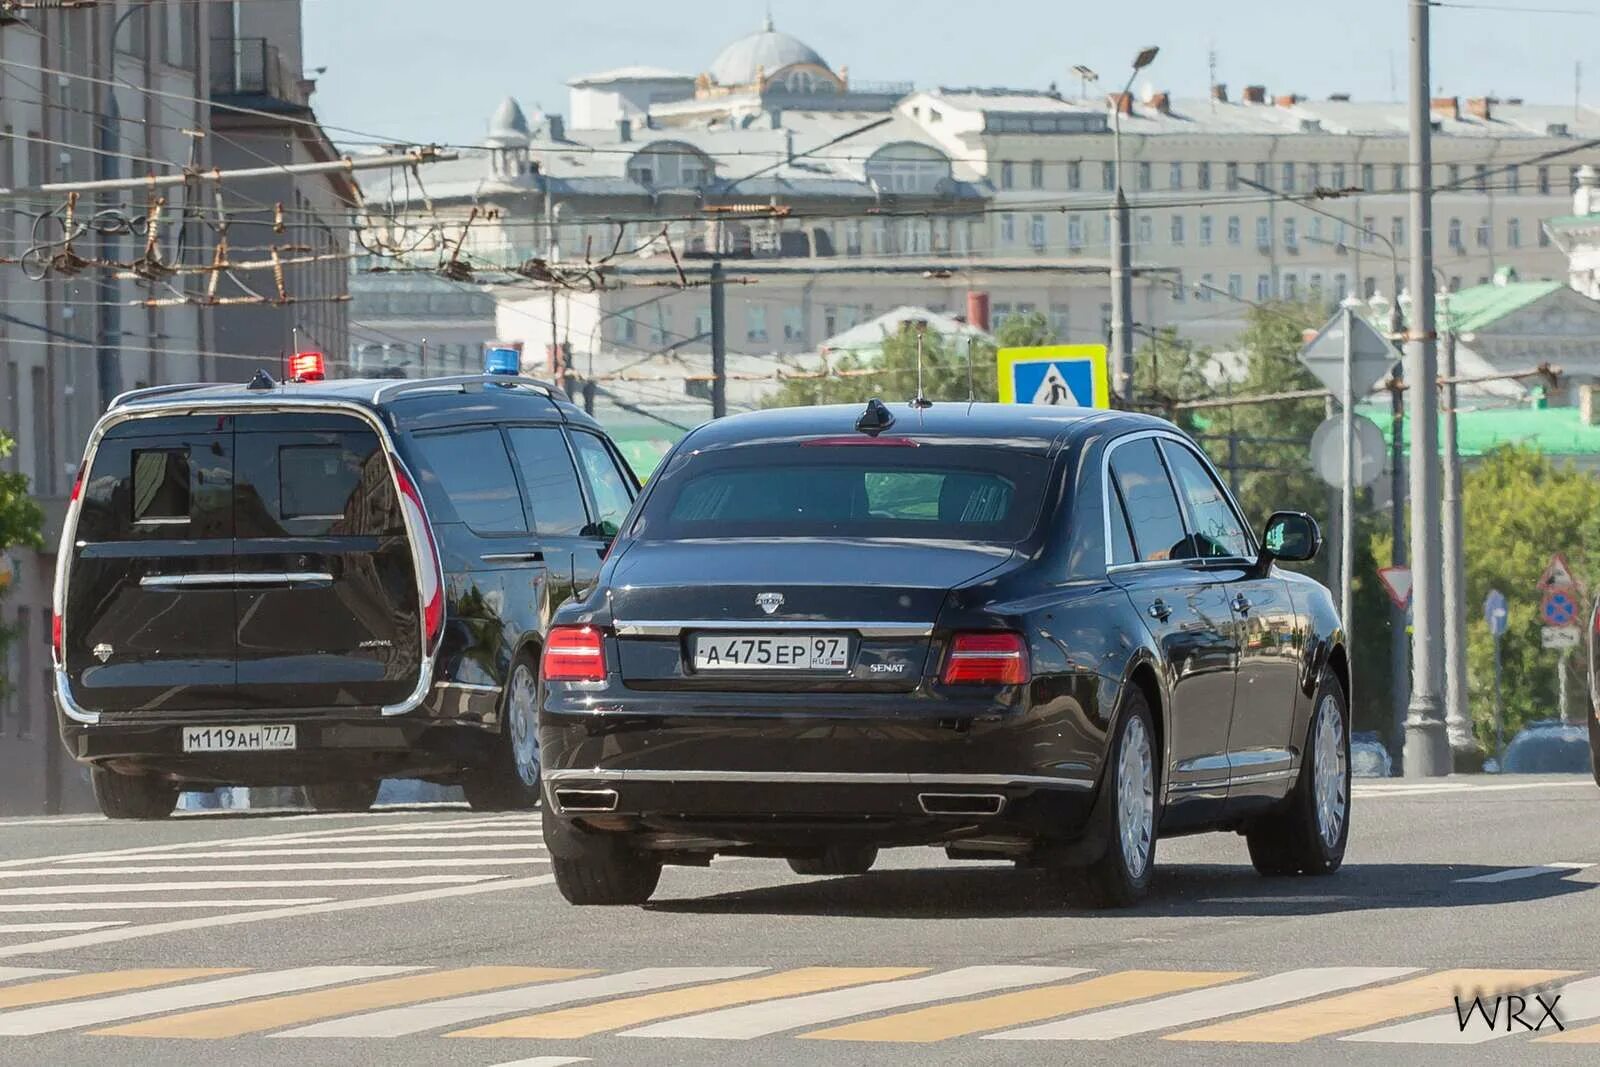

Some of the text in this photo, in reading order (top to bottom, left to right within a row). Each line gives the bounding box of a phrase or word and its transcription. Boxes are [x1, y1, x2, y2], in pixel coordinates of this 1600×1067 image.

[707, 640, 839, 664] А475ЕР 97
[870, 664, 905, 673] SENAT
[188, 727, 290, 748] М119АН 777
